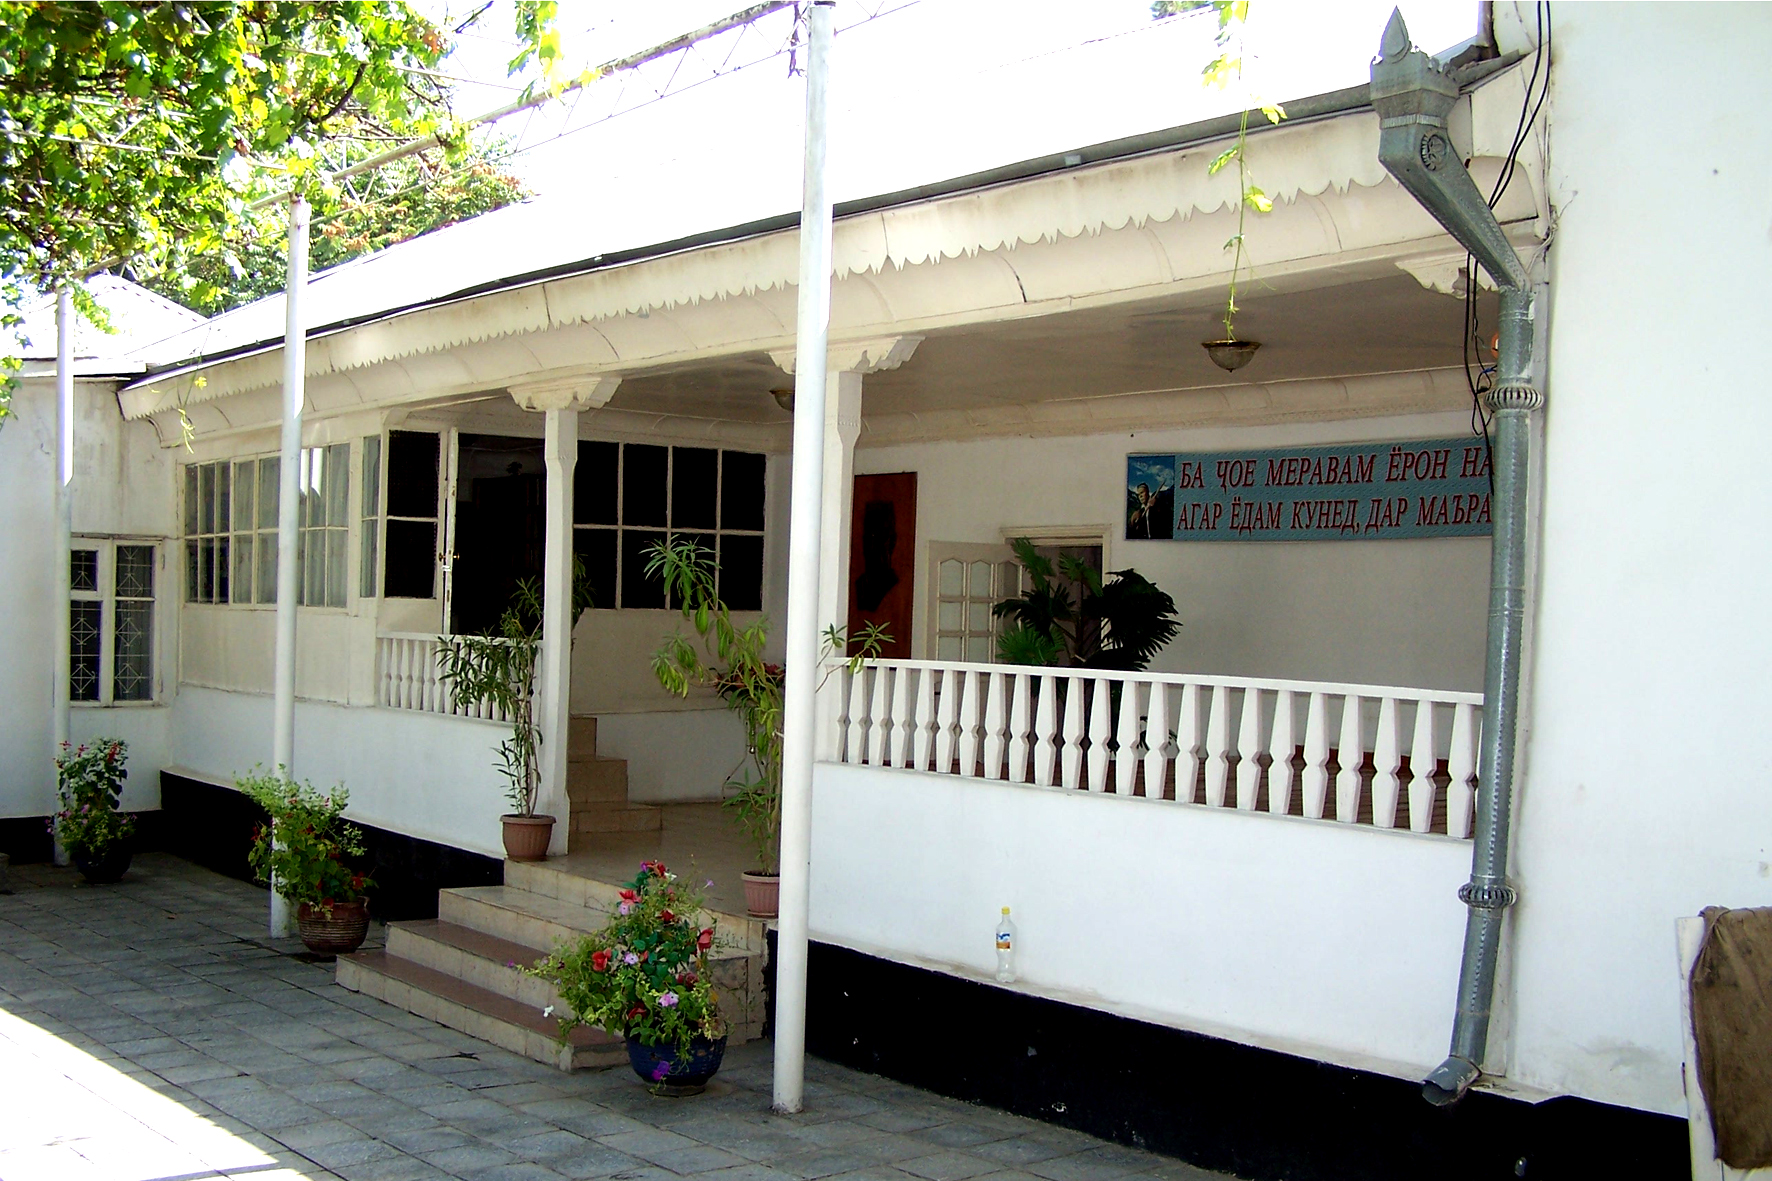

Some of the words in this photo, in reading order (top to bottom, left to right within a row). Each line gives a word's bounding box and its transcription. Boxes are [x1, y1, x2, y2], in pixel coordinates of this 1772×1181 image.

[1179, 462, 1205, 489] БА
[1216, 459, 1257, 495] ҶОЕ
[1264, 454, 1377, 487] МЕРАВАМ
[1385, 446, 1451, 482] ЁРОН
[1177, 502, 1222, 530] АГАР
[1229, 496, 1283, 536] ЁДАМ
[1290, 499, 1360, 536] КУНЕД,
[1364, 497, 1408, 534] ДАР
